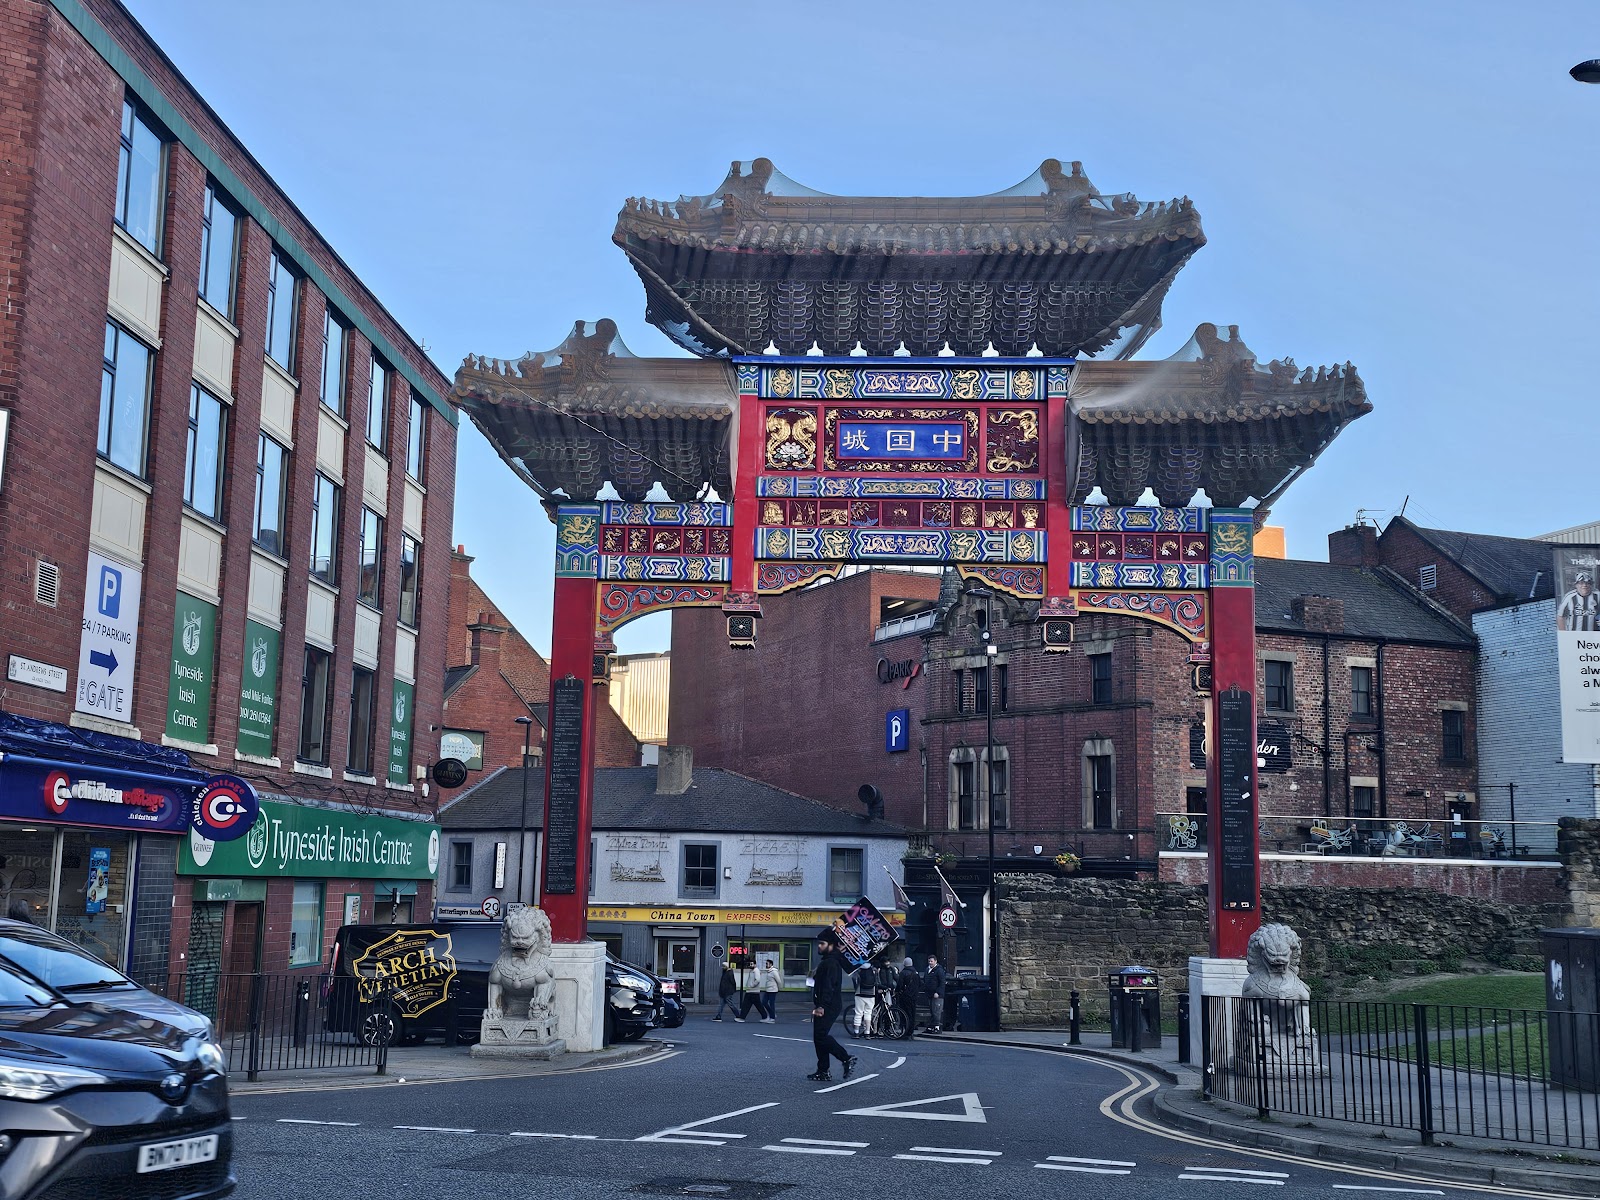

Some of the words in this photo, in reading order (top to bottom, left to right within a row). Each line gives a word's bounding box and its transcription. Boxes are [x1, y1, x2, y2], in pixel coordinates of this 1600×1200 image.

[102, 570, 118, 611] P
[101, 624, 132, 645] PARKING
[174, 660, 203, 683] Tyneside
[86, 680, 124, 713] GATE
[178, 686, 196, 705] Irish
[173, 709, 198, 729] Centre
[891, 720, 901, 747] P
[191, 787, 210, 826] chicken
[208, 779, 246, 796] cottage
[271, 818, 336, 870] Tyneside
[338, 826, 369, 863] Irish
[372, 830, 413, 866] Centre
[484, 902, 499, 912] 20
[650, 910, 683, 921] China
[686, 910, 716, 921] Town
[725, 912, 772, 922] EXPRESS
[942, 912, 955, 922] 20
[375, 946, 437, 978] ARCH
[729, 946, 748, 955] OPEN
[363, 959, 451, 995] VENETIAN
